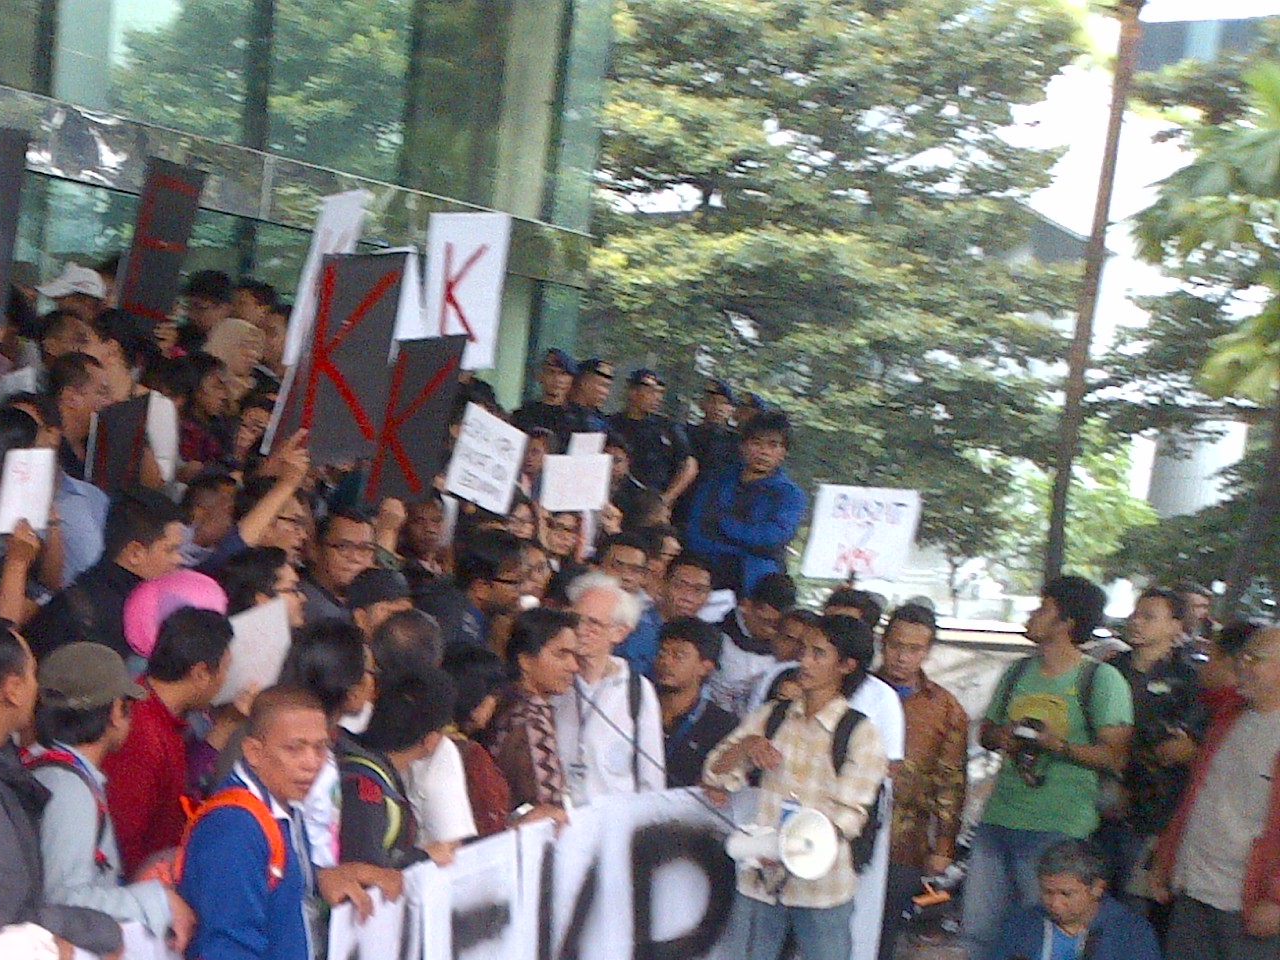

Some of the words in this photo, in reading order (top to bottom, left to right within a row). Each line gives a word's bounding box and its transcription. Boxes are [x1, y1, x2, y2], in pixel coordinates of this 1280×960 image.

[300, 263, 401, 447] K
[439, 242, 490, 343] K
[365, 351, 460, 498] K
